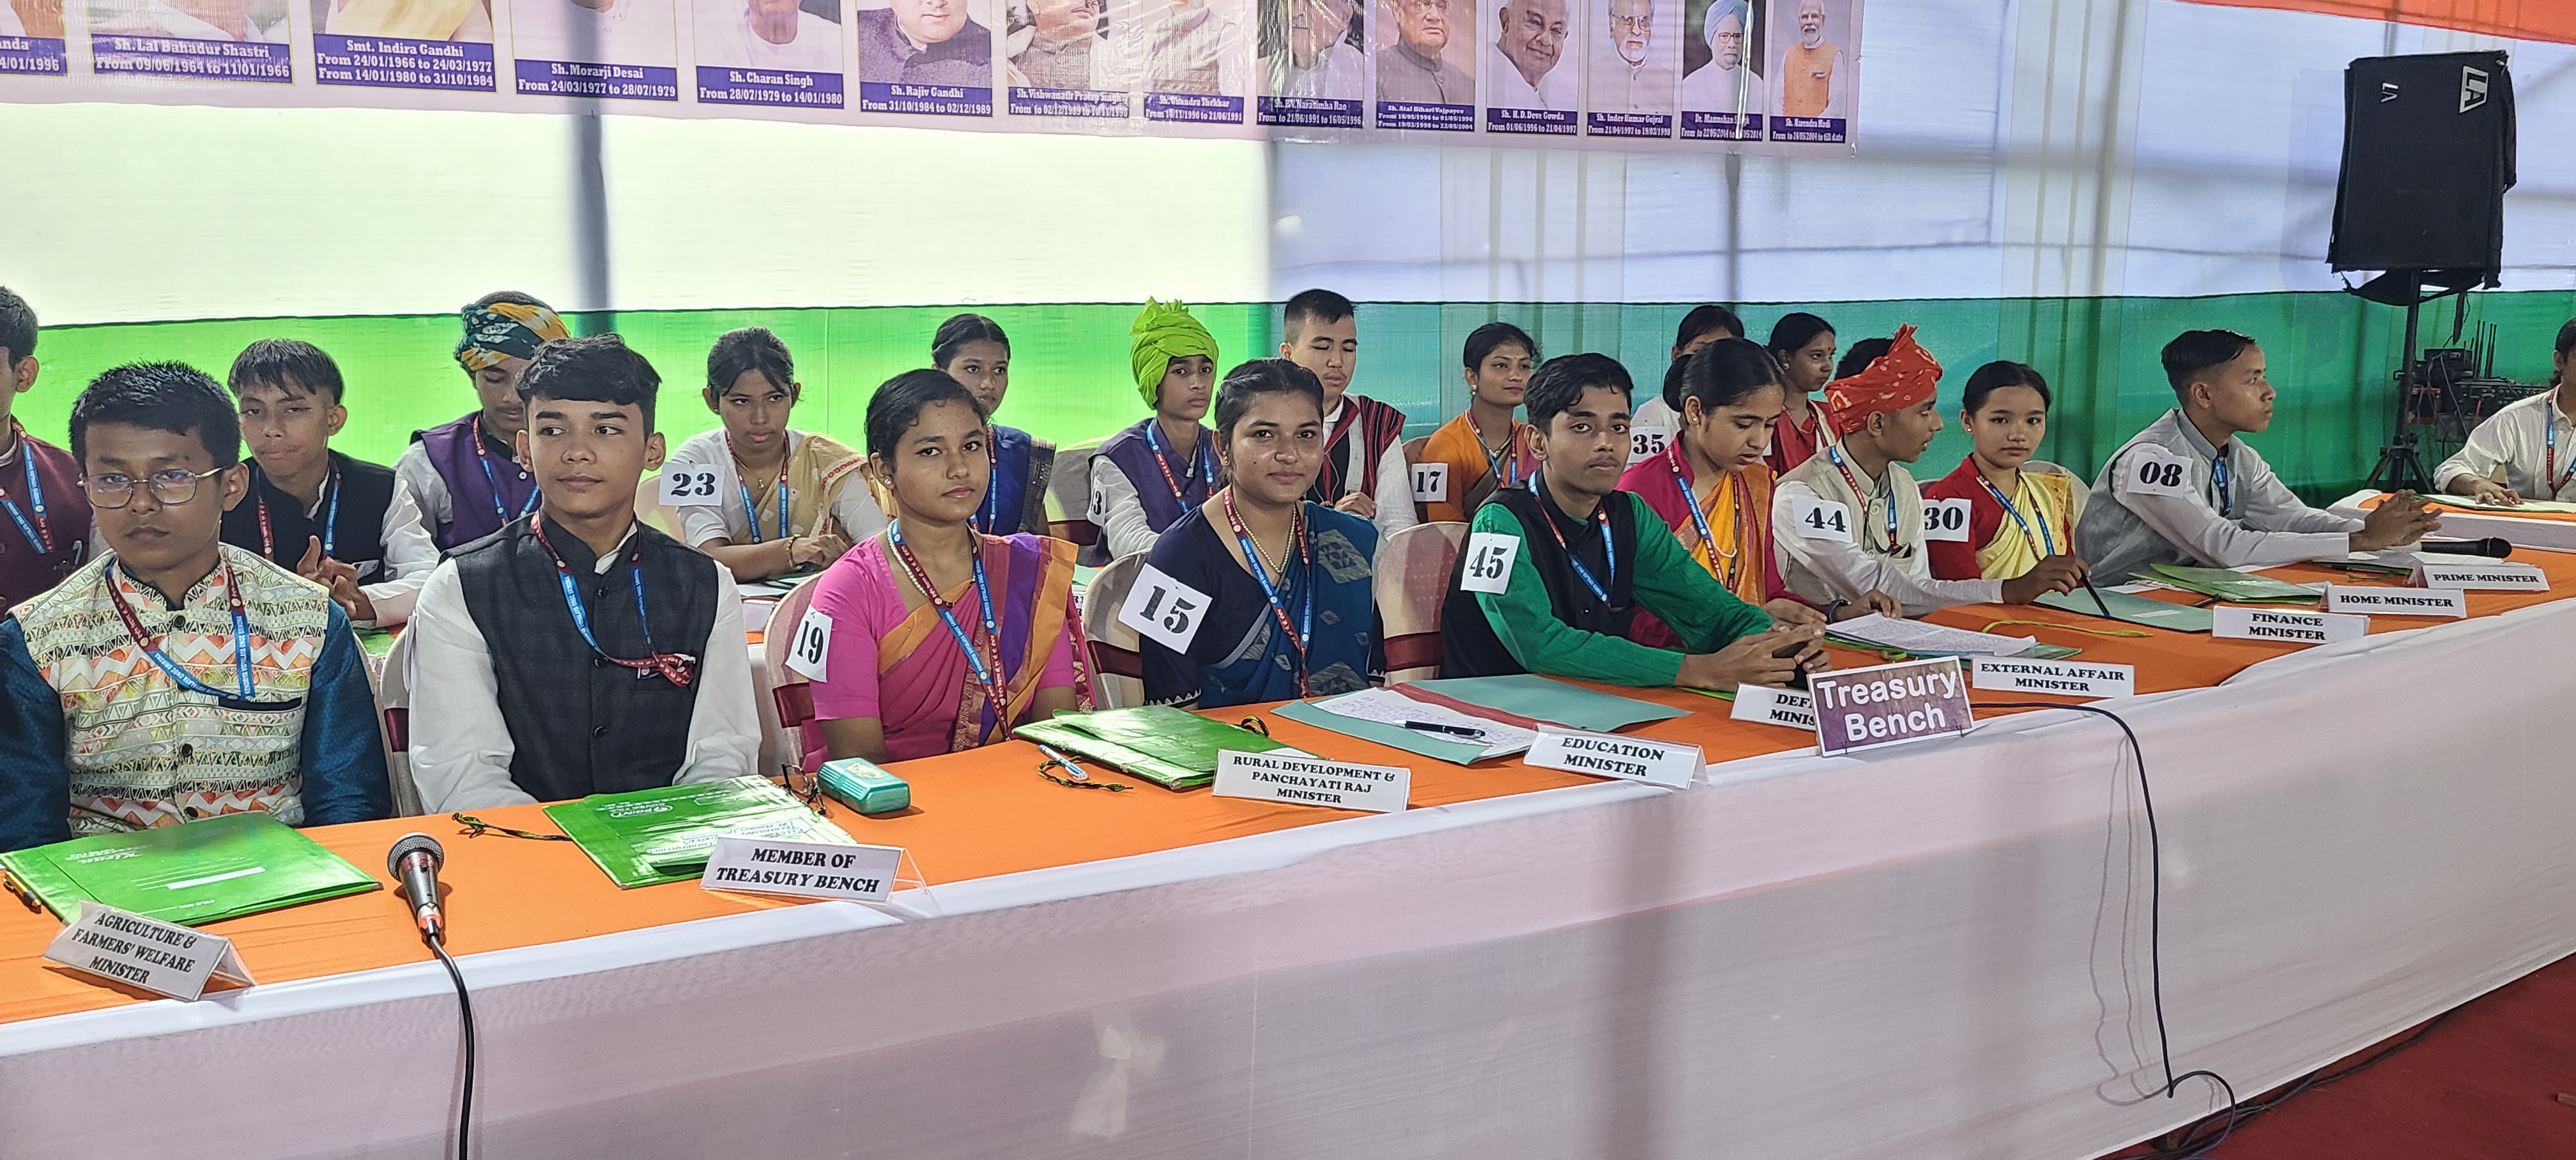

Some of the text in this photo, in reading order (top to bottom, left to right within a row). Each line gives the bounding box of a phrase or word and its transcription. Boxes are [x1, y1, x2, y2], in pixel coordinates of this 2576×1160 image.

[161, 40, 220, 56] Bahadur
[224, 43, 270, 58] Shastri
[347, 40, 464, 57] Smt. Indira Gandhi
[96, 57, 134, 70] From
[207, 63, 220, 75] to
[224, 64, 289, 77] 11/01/1966
[317, 53, 492, 72] From 24/01/1966 to 24/03/1977
[319, 68, 493, 87] From 14/01/1980 to 31/10/1984
[613, 67, 643, 79] Desai
[785, 74, 813, 88] Singh
[518, 79, 675, 96] From 24/03/1977 to 28/07/1979
[700, 88, 842, 104] From 28/07/1979 to 14/01/1980
[931, 88, 963, 98] Gandhi
[862, 100, 990, 114] From 31/10/1984 to 02/12/1989
[1011, 103, 1031, 114] From
[1202, 97, 1230, 107] Shekhar
[1334, 102, 1346, 111] Rao
[1146, 109, 1163, 118] From
[1209, 111, 1242, 121] 21/06/1991
[1259, 112, 1276, 122] From
[1279, 114, 1285, 122] to
[1287, 114, 1319, 123] 21/06/1991
[1544, 112, 1564, 120] Gowda
[1646, 116, 1663, 125] Gujral
[1488, 122, 1505, 131] From
[1632, 434, 1664, 455] 35
[1416, 471, 1441, 493] 17
[2140, 462, 2182, 487] 08
[671, 473, 716, 496] 23
[1805, 507, 1846, 533] 44
[1924, 507, 1963, 530] 30
[1469, 546, 1508, 579] 45
[2478, 574, 2540, 583] MINISTER
[1140, 585, 1197, 634] 15
[2340, 595, 2454, 607] HOME MINISTER
[2252, 613, 2323, 627] FINANCE
[797, 620, 824, 664] 19
[2249, 626, 2326, 640] MINISTER
[1981, 664, 2125, 680] EXTERNAL AFFAIR
[1817, 671, 1956, 710] Treasury
[2015, 678, 2090, 691] MINISTER
[1844, 703, 1946, 742] Bench
[1561, 738, 1665, 761] EDUCATION
[1233, 756, 1395, 781] RURAL DEVELOPMENT &
[1563, 754, 1647, 776] MINISTER
[1252, 772, 1372, 793] PANCHAYATI RAJ
[1276, 788, 1341, 803] MINISTER
[751, 848, 856, 868] MEMBER OF
[716, 867, 879, 892] TREASURY BENCH
[95, 913, 197, 949] AGRICULTURE &
[72, 928, 195, 973] FARMERS' WELFARE
[89, 956, 150, 984] MINISTER
